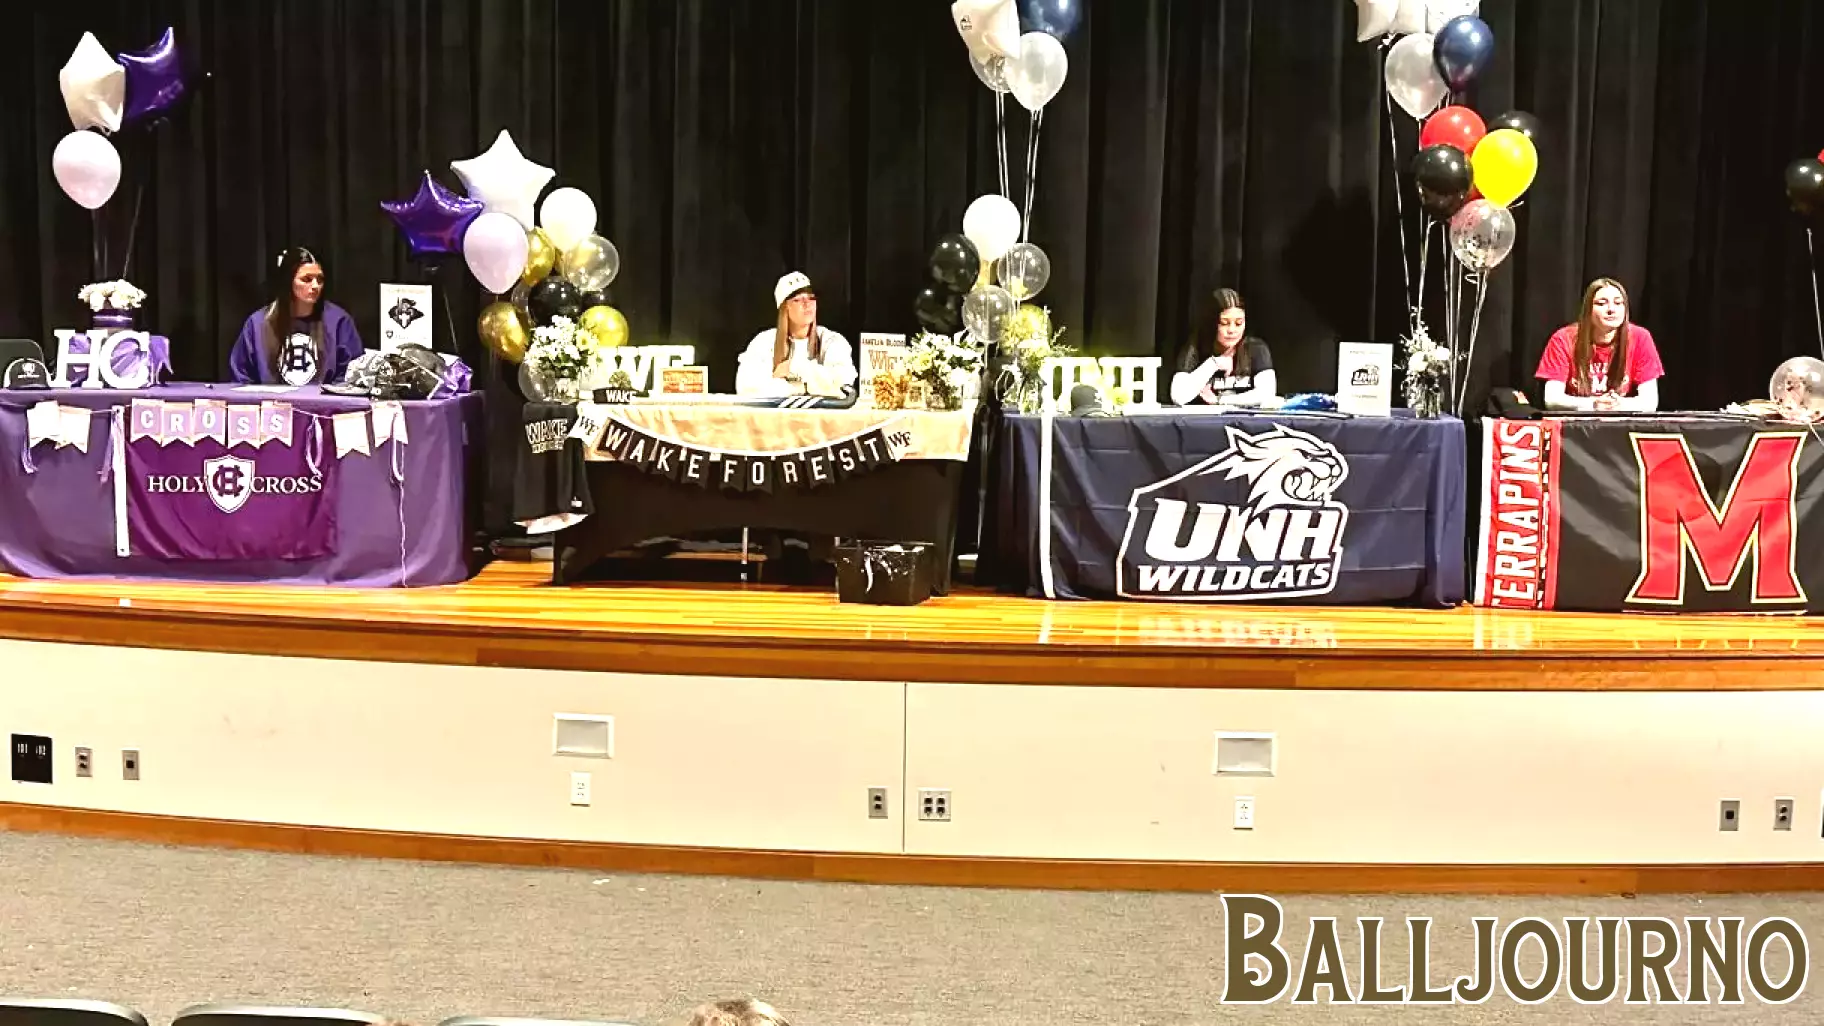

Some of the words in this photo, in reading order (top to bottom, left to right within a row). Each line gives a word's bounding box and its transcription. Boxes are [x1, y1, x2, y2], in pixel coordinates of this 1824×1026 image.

[50, 329, 150, 389] HC
[606, 389, 637, 402] WAKE
[140, 409, 284, 435] CROSS
[888, 431, 912, 447] WF
[605, 424, 704, 479] WAKE
[723, 437, 880, 484] FOREST
[147, 475, 207, 493] HOLY
[251, 475, 322, 493] CROSS
[1145, 497, 1341, 562] UNH
[1623, 431, 1809, 605] M
[1137, 563, 1332, 592] WILDCATS
